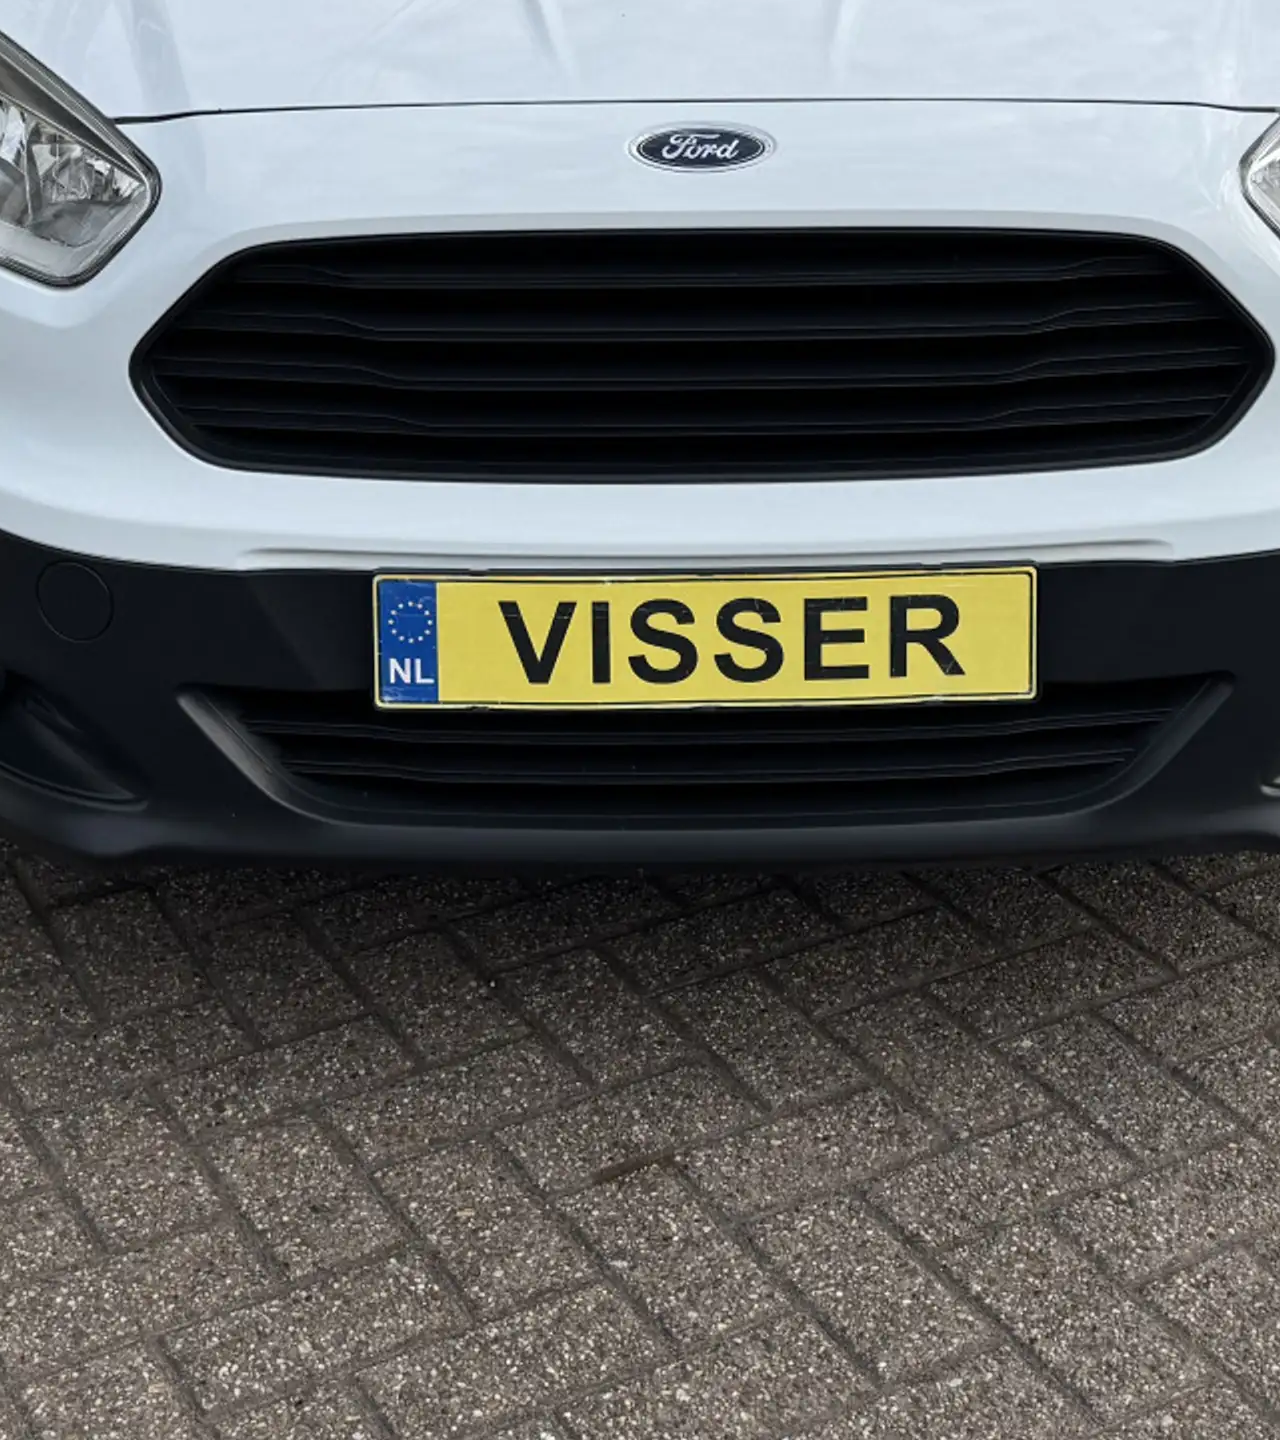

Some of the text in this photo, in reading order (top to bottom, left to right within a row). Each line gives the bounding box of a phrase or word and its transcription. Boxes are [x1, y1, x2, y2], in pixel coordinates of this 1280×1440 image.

[661, 133, 740, 160] Ford
[497, 593, 966, 686] VISSER
[388, 657, 435, 685] NL
